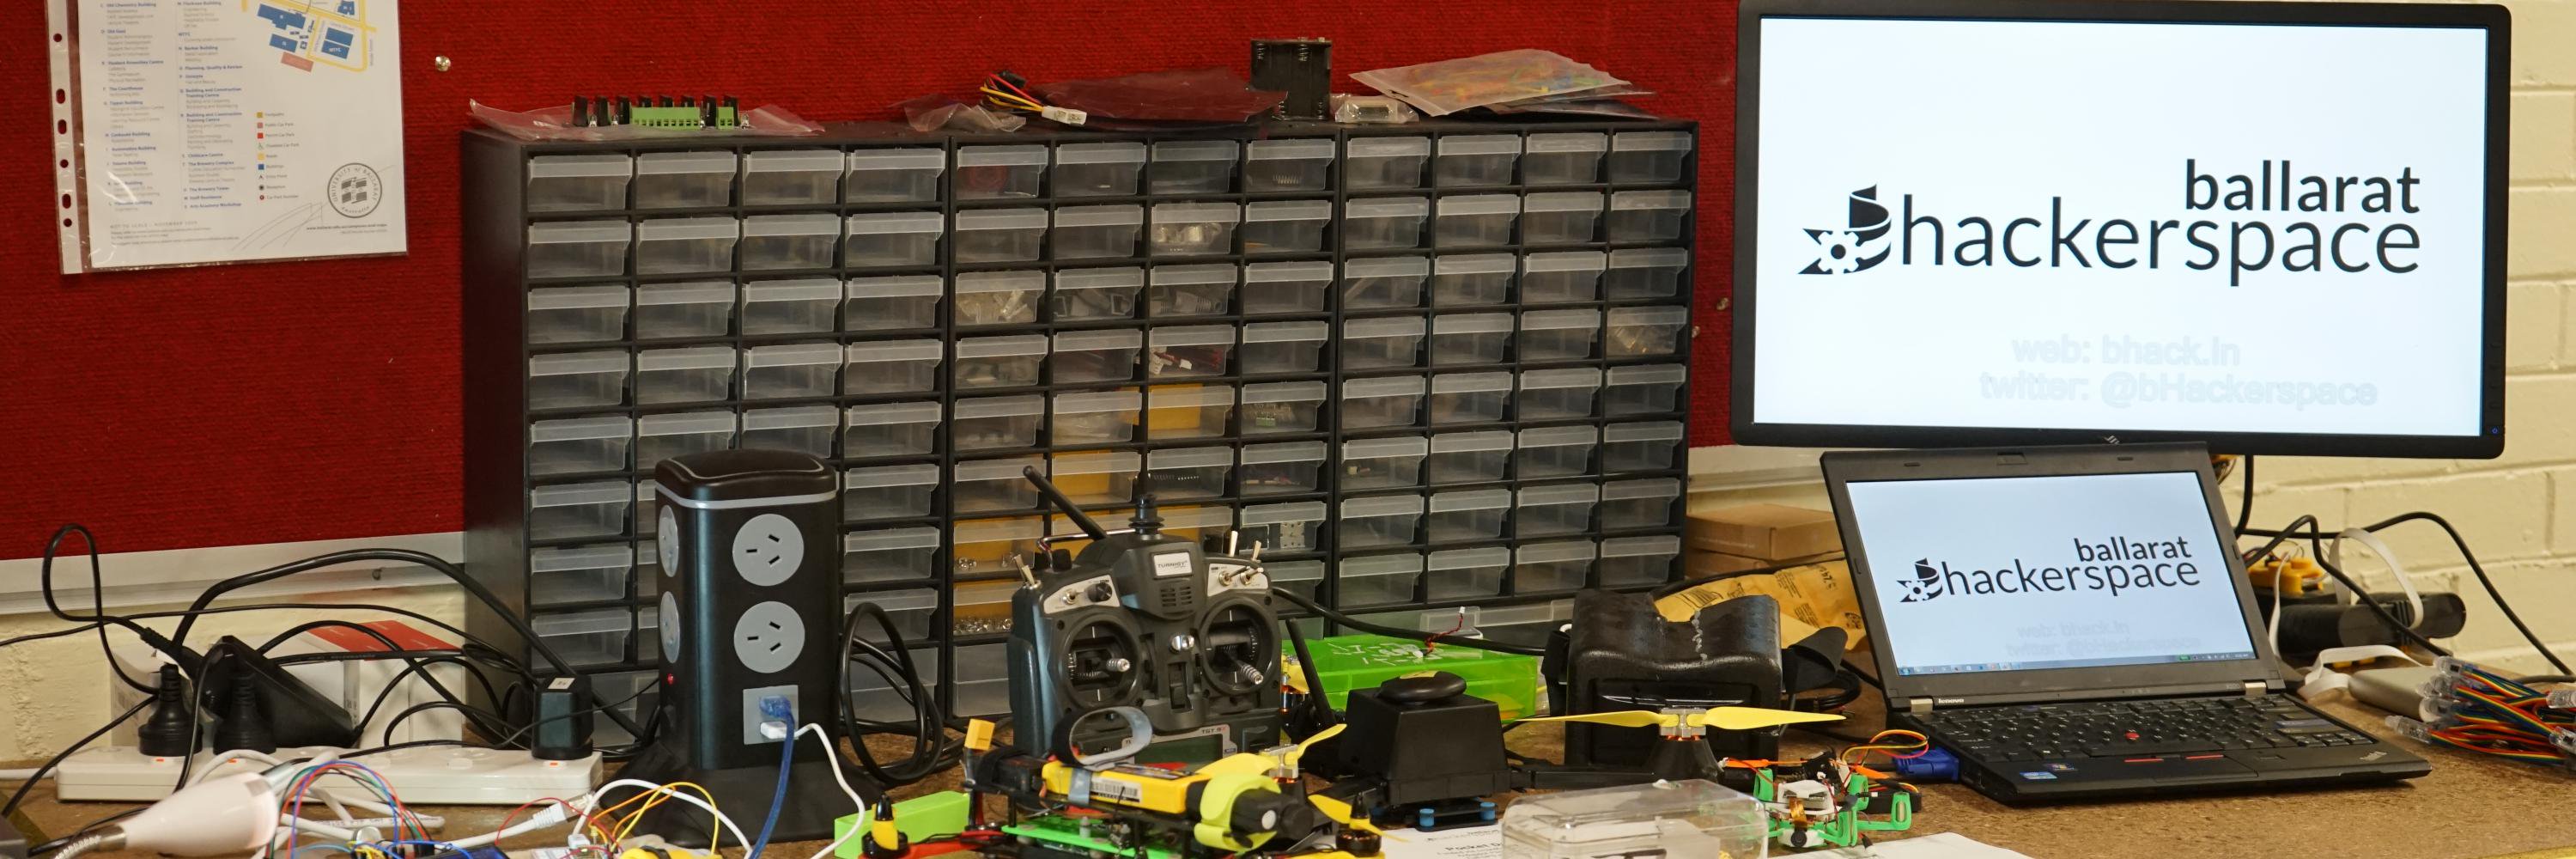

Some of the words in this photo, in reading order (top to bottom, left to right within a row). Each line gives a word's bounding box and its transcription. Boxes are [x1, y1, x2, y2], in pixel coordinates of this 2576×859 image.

[2185, 158, 2421, 214] ballarat
[1902, 193, 2421, 287] hackerspace
[2011, 334, 2090, 364] web:
[2101, 334, 2240, 367] bhack.in
[1978, 371, 2090, 402] twitter:
[2100, 371, 2379, 411] @bHackerspace
[2074, 536, 2193, 563] ballarat
[1941, 558, 2201, 597] hackerspace
